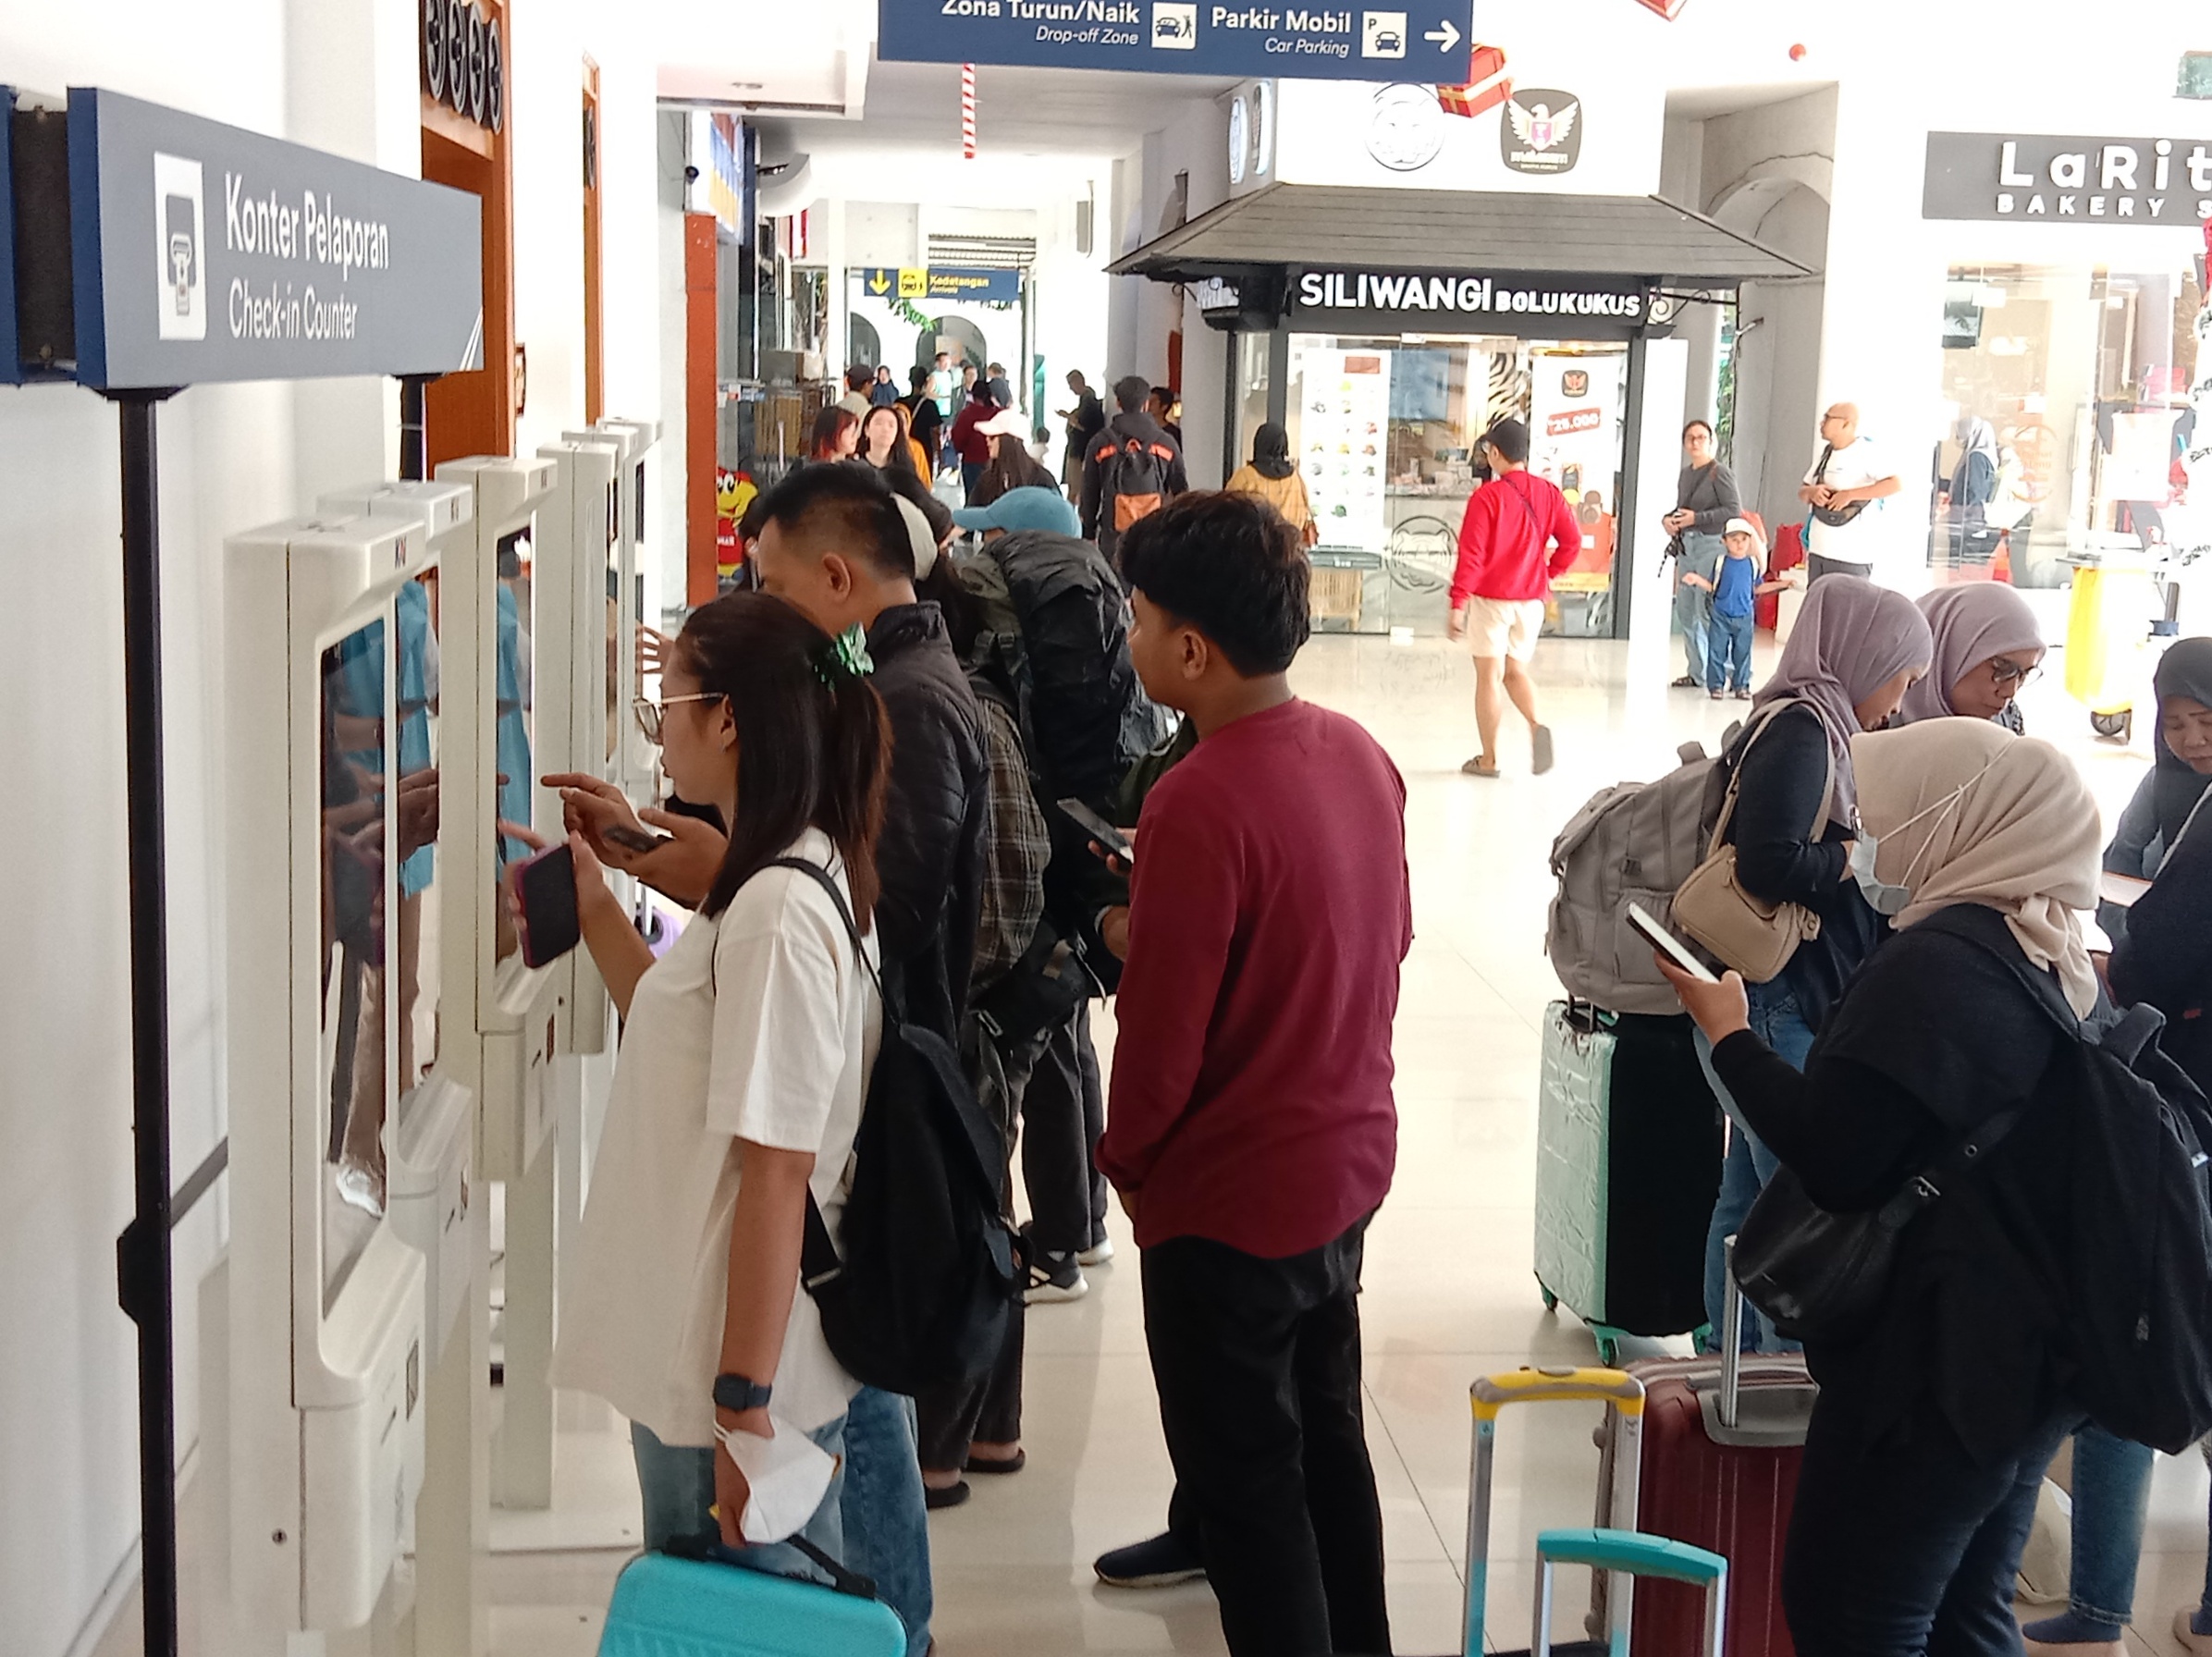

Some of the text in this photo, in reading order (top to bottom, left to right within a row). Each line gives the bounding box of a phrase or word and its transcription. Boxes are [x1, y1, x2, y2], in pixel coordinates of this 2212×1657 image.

[941, 0, 1140, 24] Zona Turun/Naik
[1211, 6, 1352, 33] Parkir Mobil
[1036, 25, 1139, 44] Drop-off Zone
[1265, 37, 1350, 58] Car Parking
[1997, 193, 2166, 217] BAKERY
[225, 170, 390, 282] Konter Pelaporan
[1299, 273, 1641, 316] SILIWANGI BOLUKUKUS
[228, 276, 359, 340] Check-in Counter
